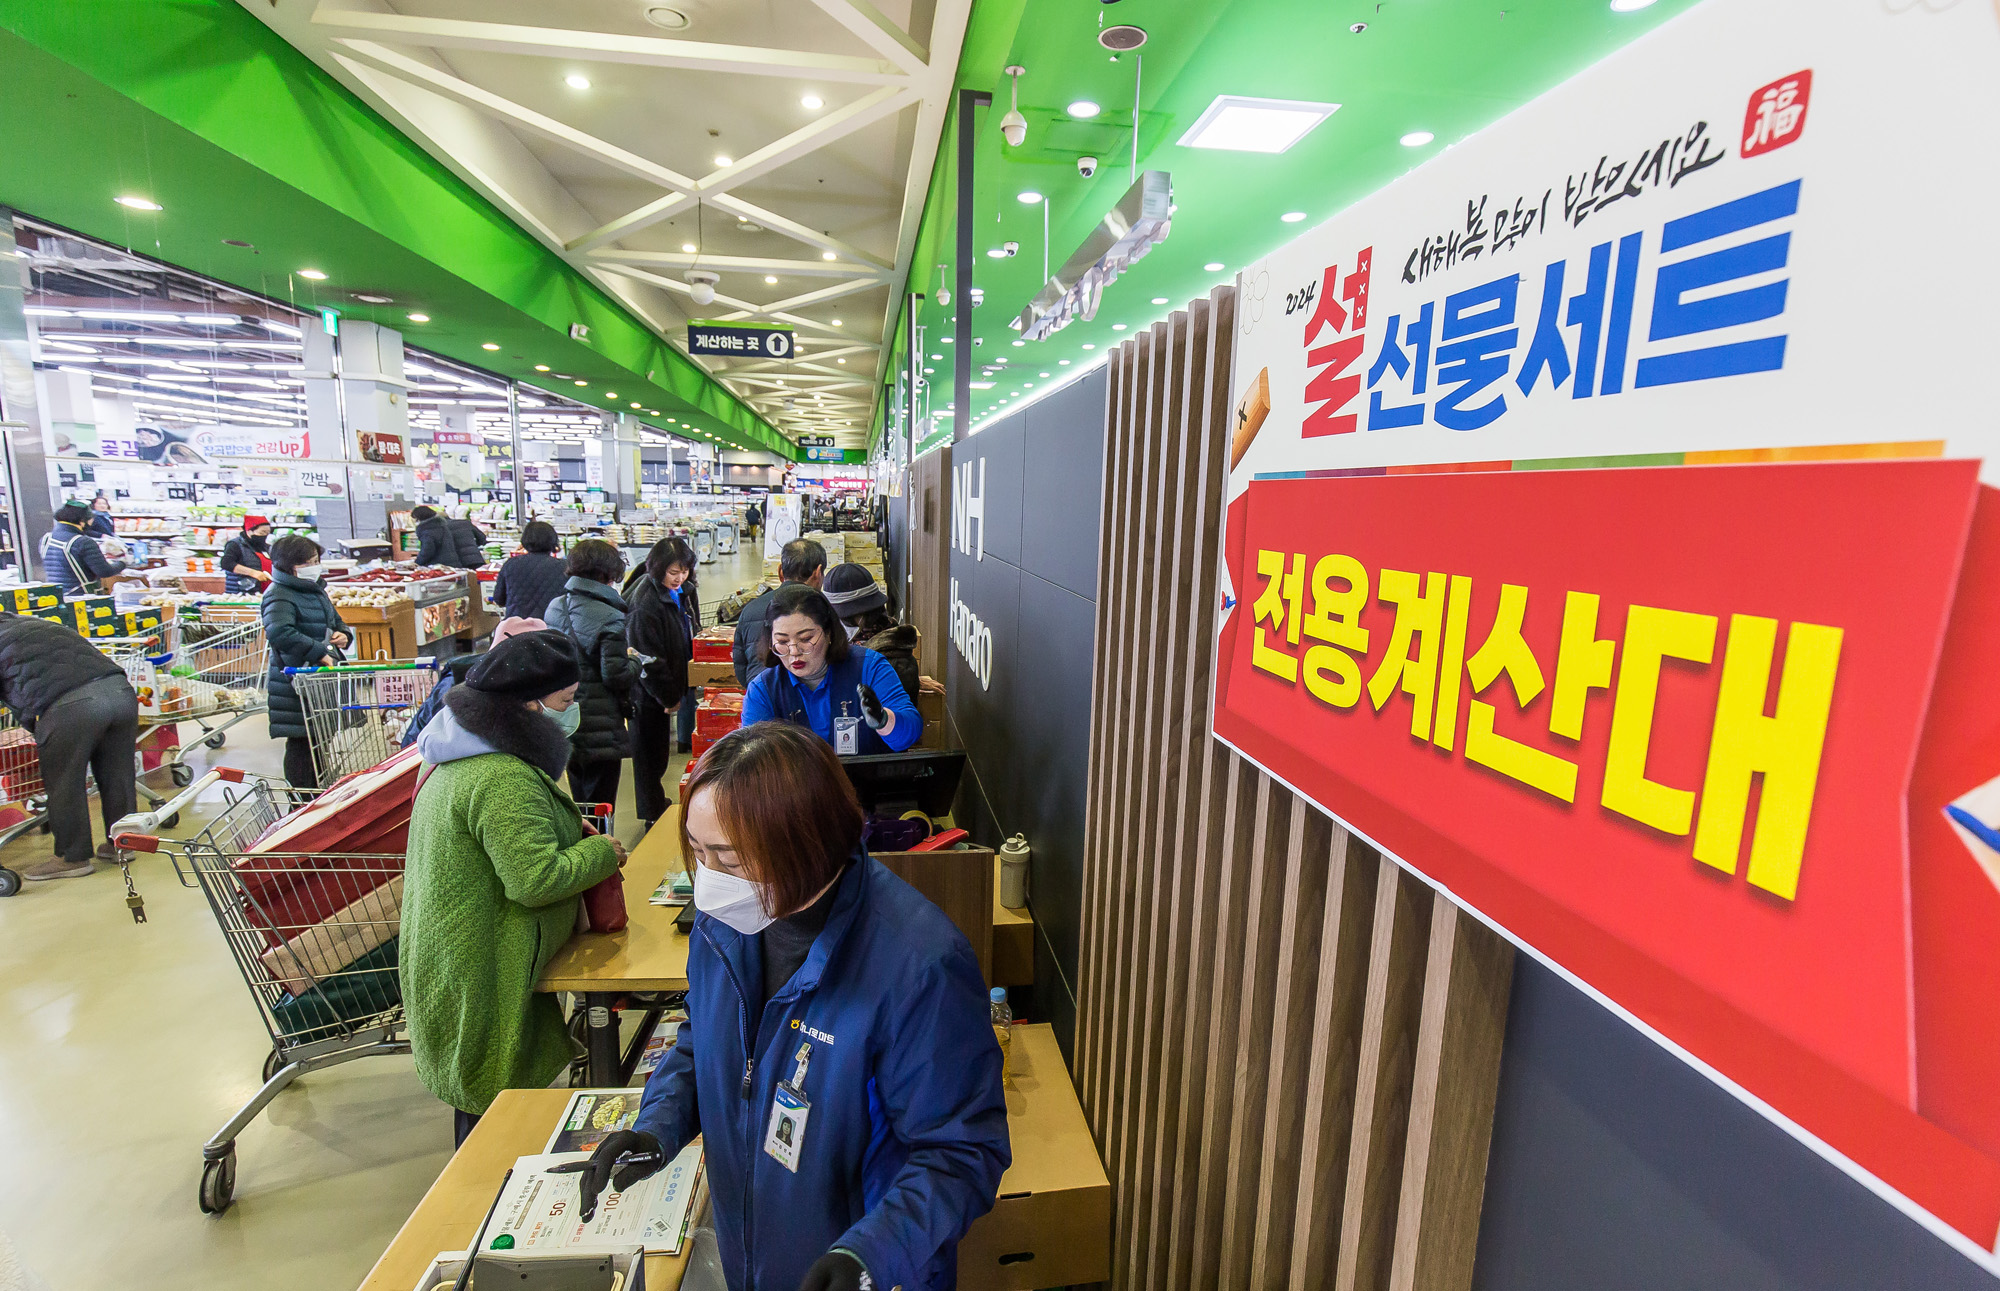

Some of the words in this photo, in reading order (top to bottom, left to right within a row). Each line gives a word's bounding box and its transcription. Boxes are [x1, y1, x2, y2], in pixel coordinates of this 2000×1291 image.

[1746, 81, 1803, 152] 福
[1492, 188, 1552, 256] 많이
[1565, 121, 1726, 229] 받으세요
[1285, 280, 1317, 316] 2024
[1301, 246, 1374, 439] 설
[1367, 177, 1803, 432] 선물세트
[695, 335, 744, 350] 계산하는
[747, 336, 760, 350] 곳
[256, 442, 278, 454] 건강
[279, 440, 300, 458] UP
[301, 472, 330, 487] 깐밤
[952, 456, 986, 563] NH
[950, 577, 993, 693] Hanaro
[1251, 548, 1845, 901] 전용계산대
[549, 1202, 567, 1217] 50
[603, 1192, 622, 1213] 100
